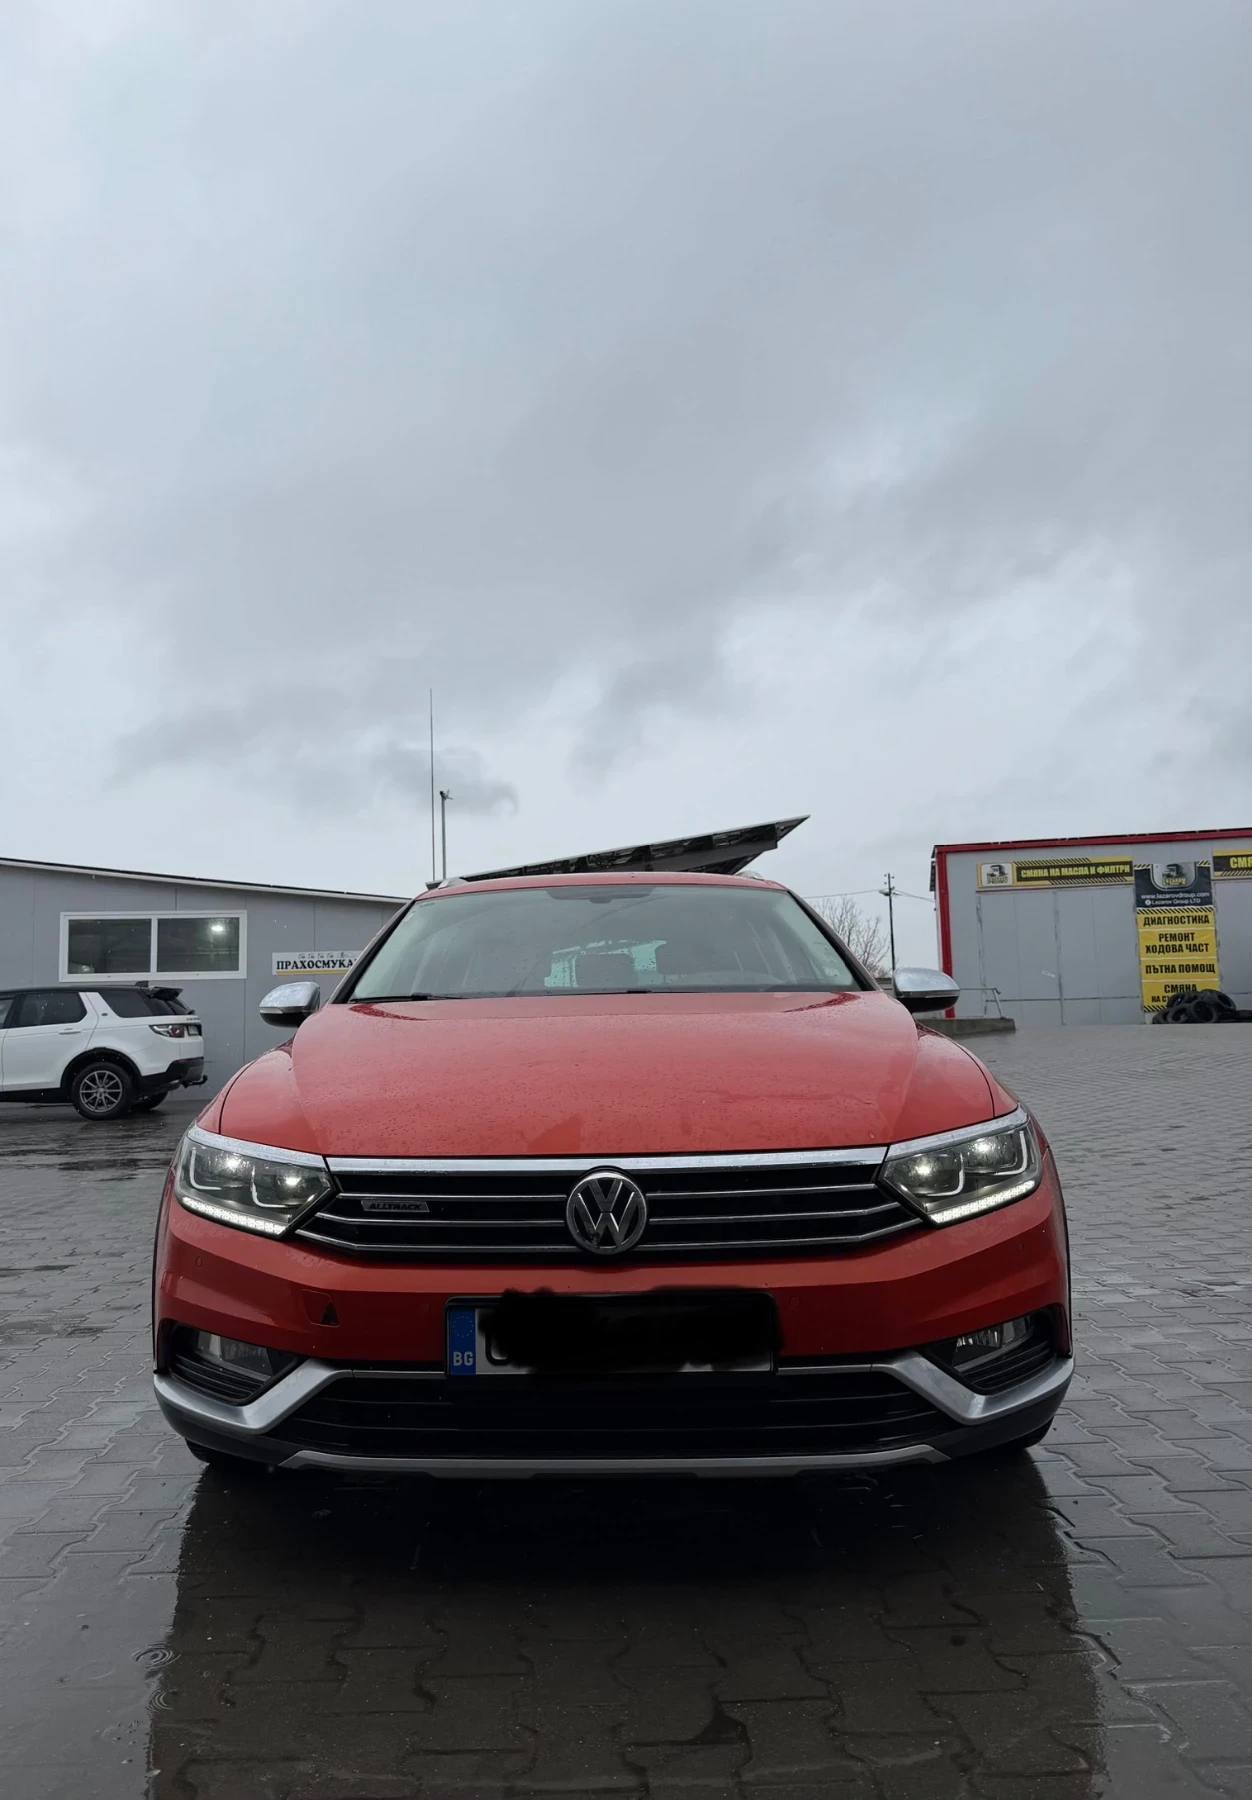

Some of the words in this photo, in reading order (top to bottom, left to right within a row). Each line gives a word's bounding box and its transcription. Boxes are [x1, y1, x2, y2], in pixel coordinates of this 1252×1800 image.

[1021, 868, 1049, 878] СМЯНА
[1049, 868, 1060, 877] НА
[1061, 867, 1089, 876] МАСЛА
[1090, 866, 1096, 875] И
[1097, 865, 1130, 874] ФИЛТРИ
[1143, 915, 1210, 927] ДИАГНОСТИКА
[1158, 932, 1195, 942] РЕМОНТ
[1145, 944, 1184, 955] ХОДОВА
[1185, 943, 1209, 952] ЧАСТ
[276, 959, 357, 970] ПРАХОСМУКА
[1145, 964, 1177, 974] ПЪТНА
[1178, 963, 1216, 974] ПОМОЩ
[1164, 984, 1197, 994] СМЯНА
[1151, 995, 1161, 1003] НА
[368, 1202, 421, 1211] ALLTRACK
[453, 1351, 474, 1367] BG
